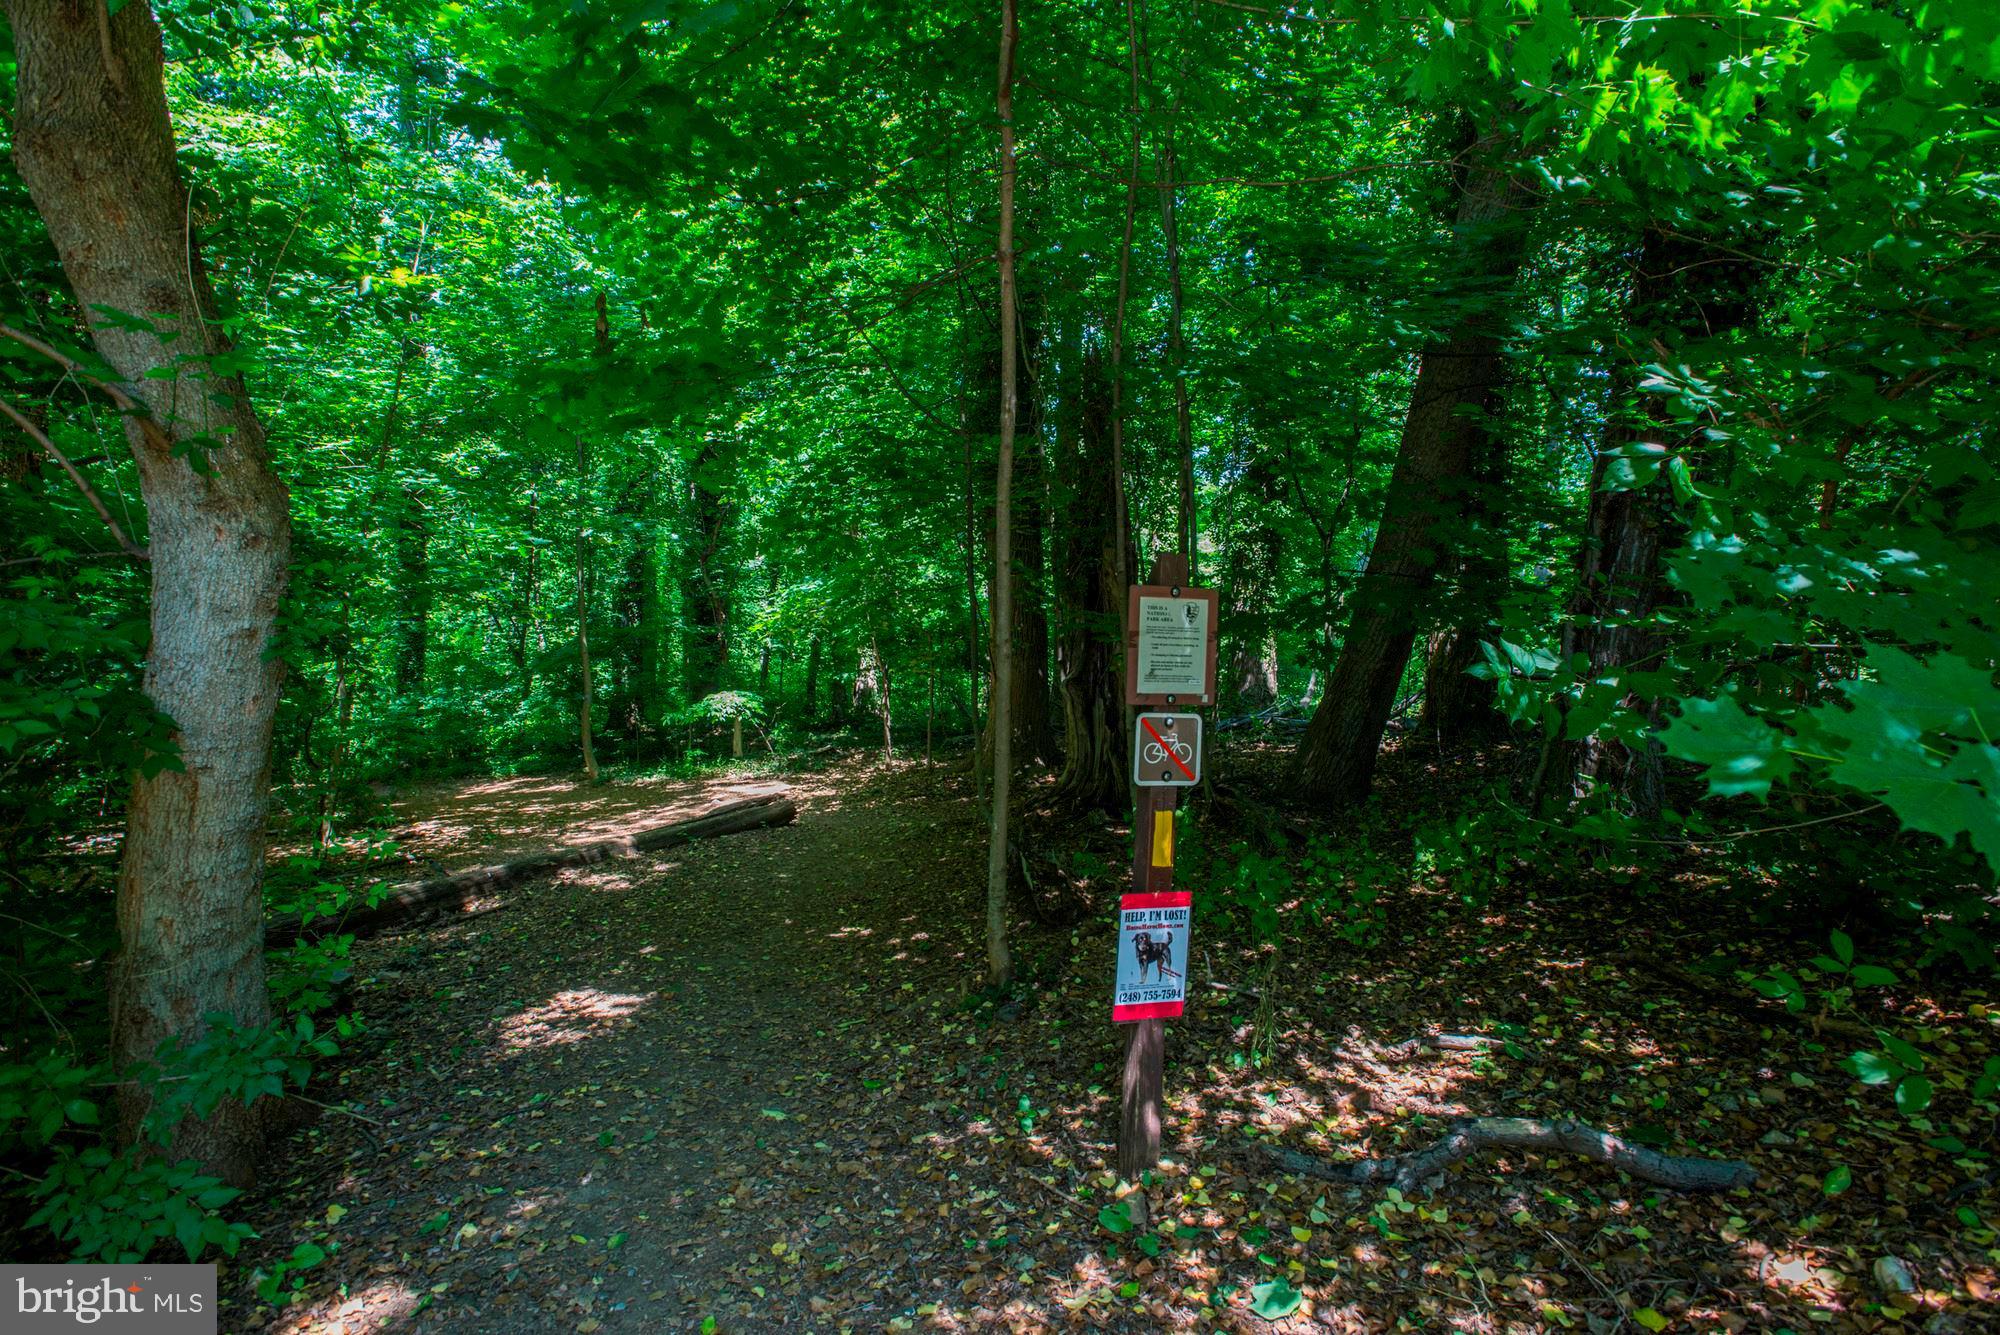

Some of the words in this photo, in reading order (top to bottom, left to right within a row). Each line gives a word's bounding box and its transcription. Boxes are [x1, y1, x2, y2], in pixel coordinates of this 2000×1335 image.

[1125, 911, 1147, 922] HELP,
[1149, 910, 1162, 921] I'M
[1164, 909, 1187, 920] LOST!
[1119, 991, 1141, 1003] (248)
[1143, 988, 1181, 1001] 755-7594
